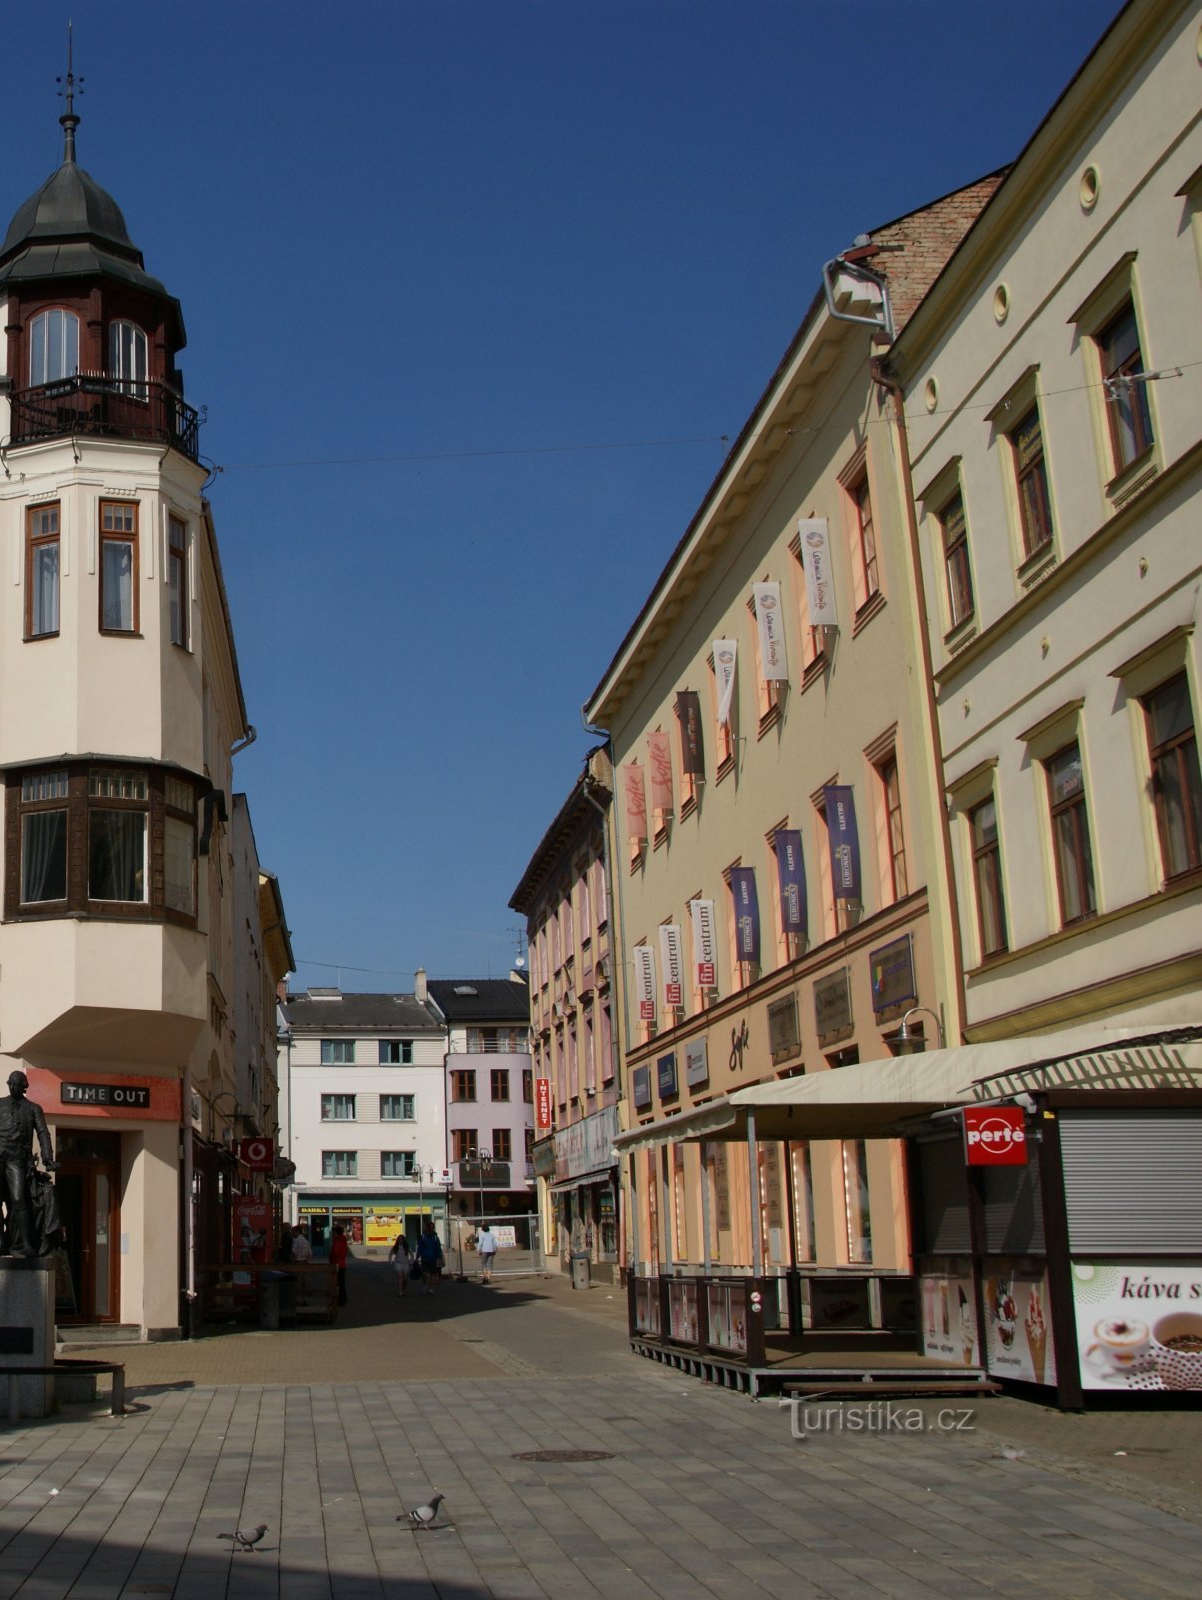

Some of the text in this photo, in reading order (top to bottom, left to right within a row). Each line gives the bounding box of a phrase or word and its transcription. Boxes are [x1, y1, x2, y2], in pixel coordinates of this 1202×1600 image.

[837, 802, 846, 830] ELEKTRO
[786, 845, 795, 870] ELEKTRO
[842, 847, 851, 886] EURONICS
[741, 880, 749, 904] ELEKTRO
[790, 887, 798, 921] EURONICS
[700, 906, 713, 982] fincentrum
[744, 918, 752, 950] EURONICS
[667, 931, 679, 1004] fincentrum
[641, 951, 653, 1018] fincentrum
[67, 1086, 146, 1103] TIME OUT
[539, 1080, 548, 1124] INTERNET
[1121, 1275, 1180, 1298] káva
